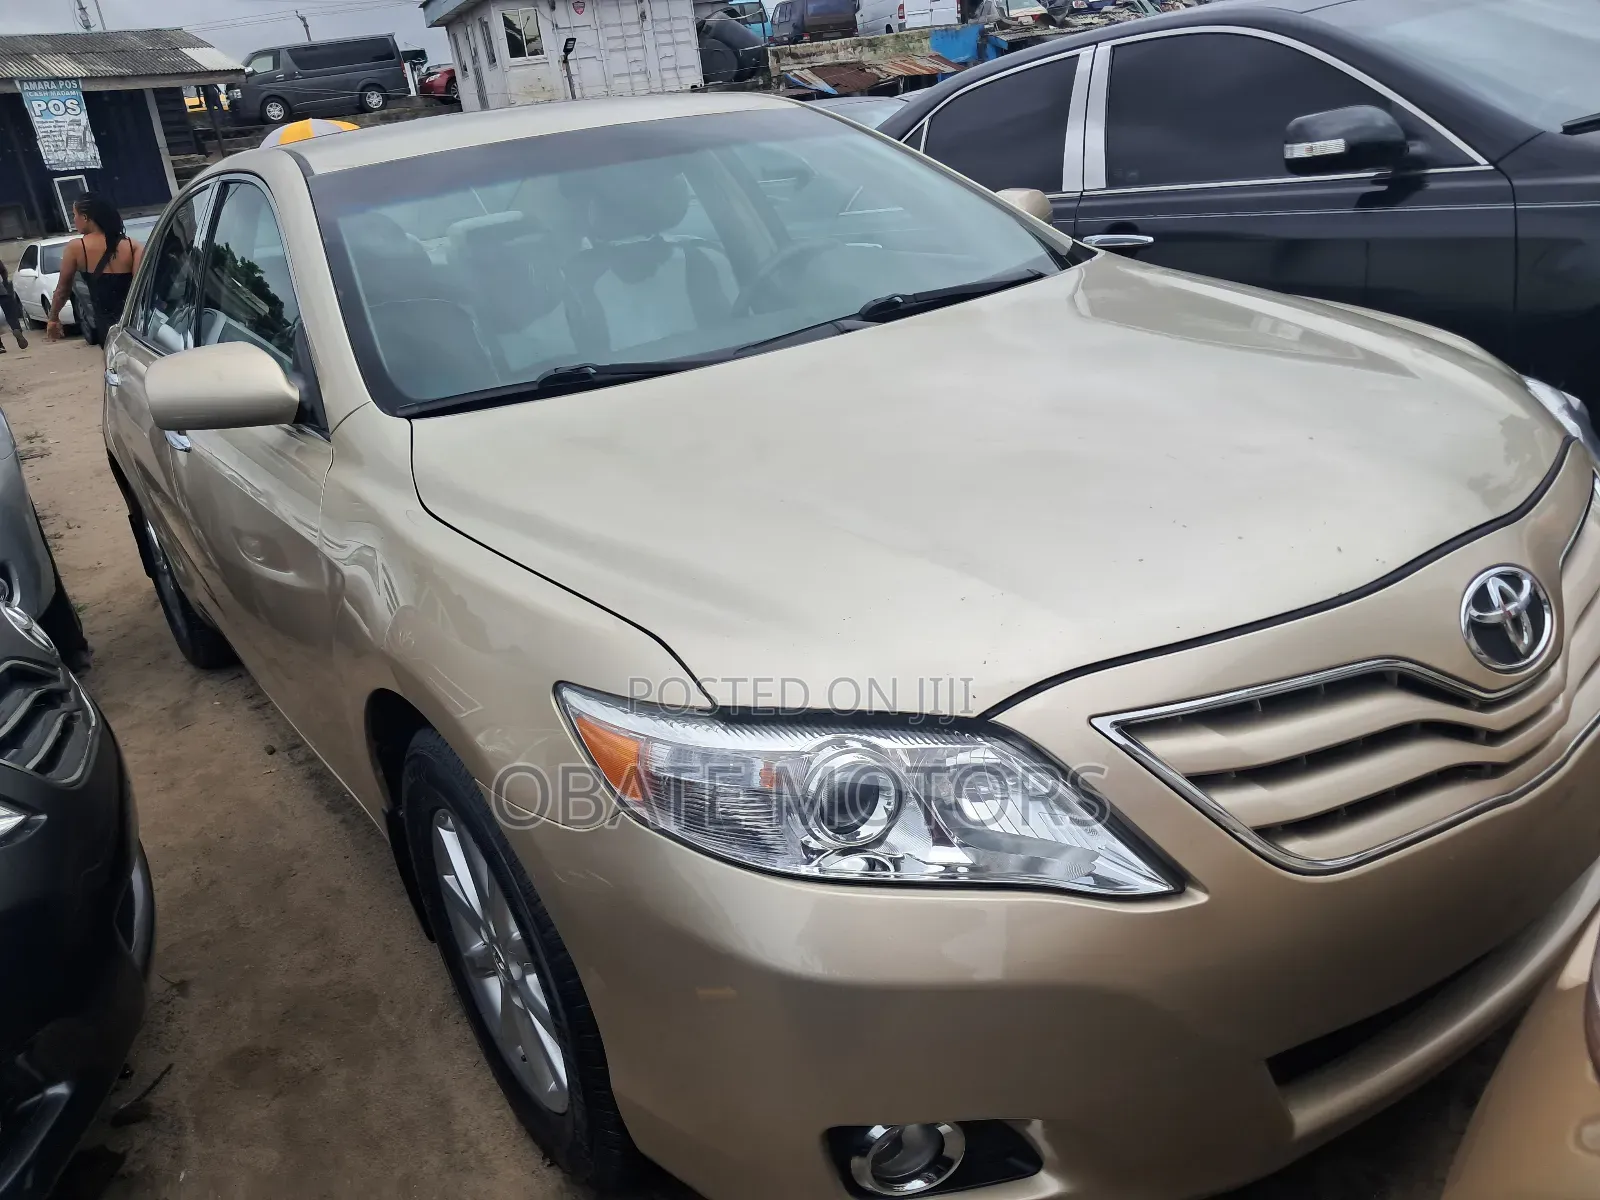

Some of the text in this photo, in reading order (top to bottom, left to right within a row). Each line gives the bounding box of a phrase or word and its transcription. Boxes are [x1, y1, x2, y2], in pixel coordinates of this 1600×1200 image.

[24, 80, 78, 91] AMARA POS
[31, 99, 82, 117] POS
